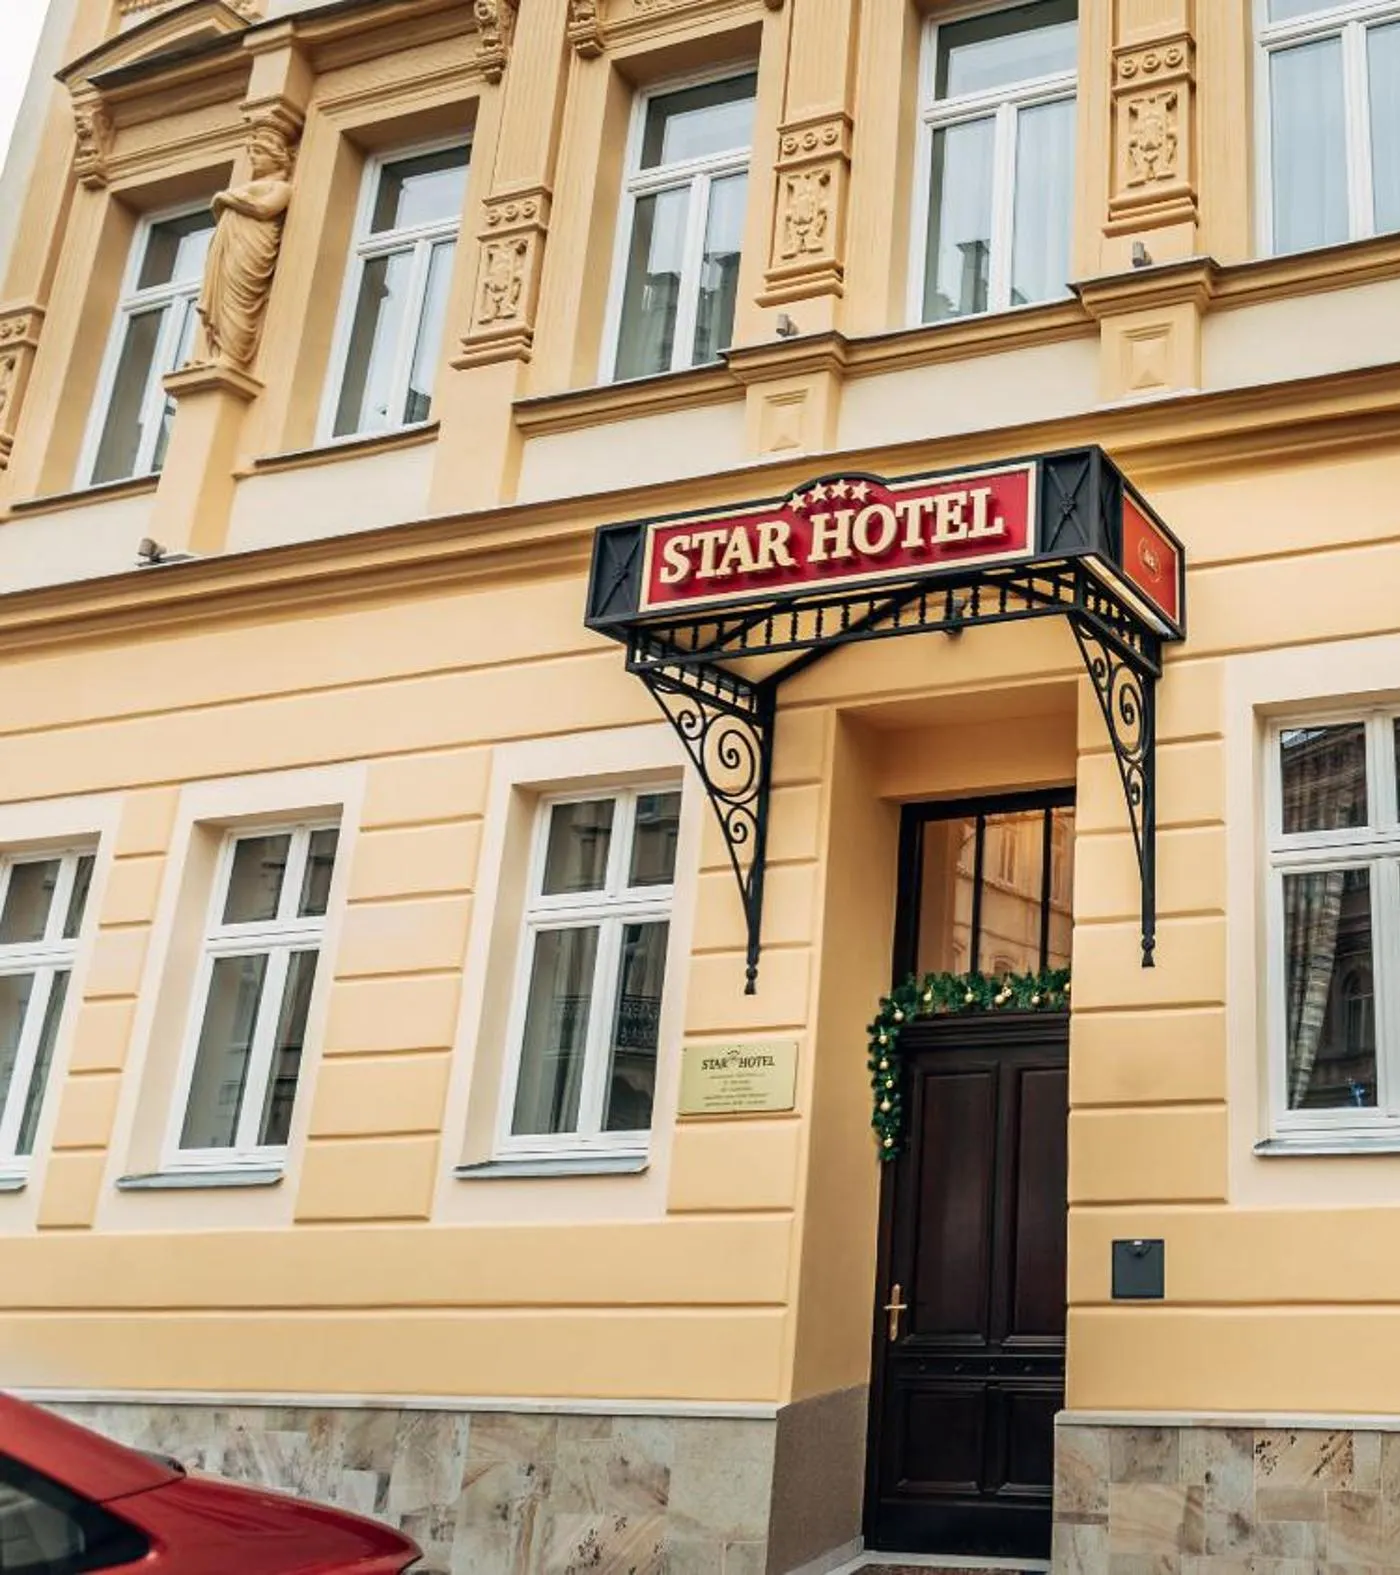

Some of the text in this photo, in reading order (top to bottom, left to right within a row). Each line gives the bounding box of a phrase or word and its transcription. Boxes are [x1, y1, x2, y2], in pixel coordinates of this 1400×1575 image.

[659, 486, 1006, 585] STAR HOTEL
[701, 1055, 776, 1070] STAR HOTEL
